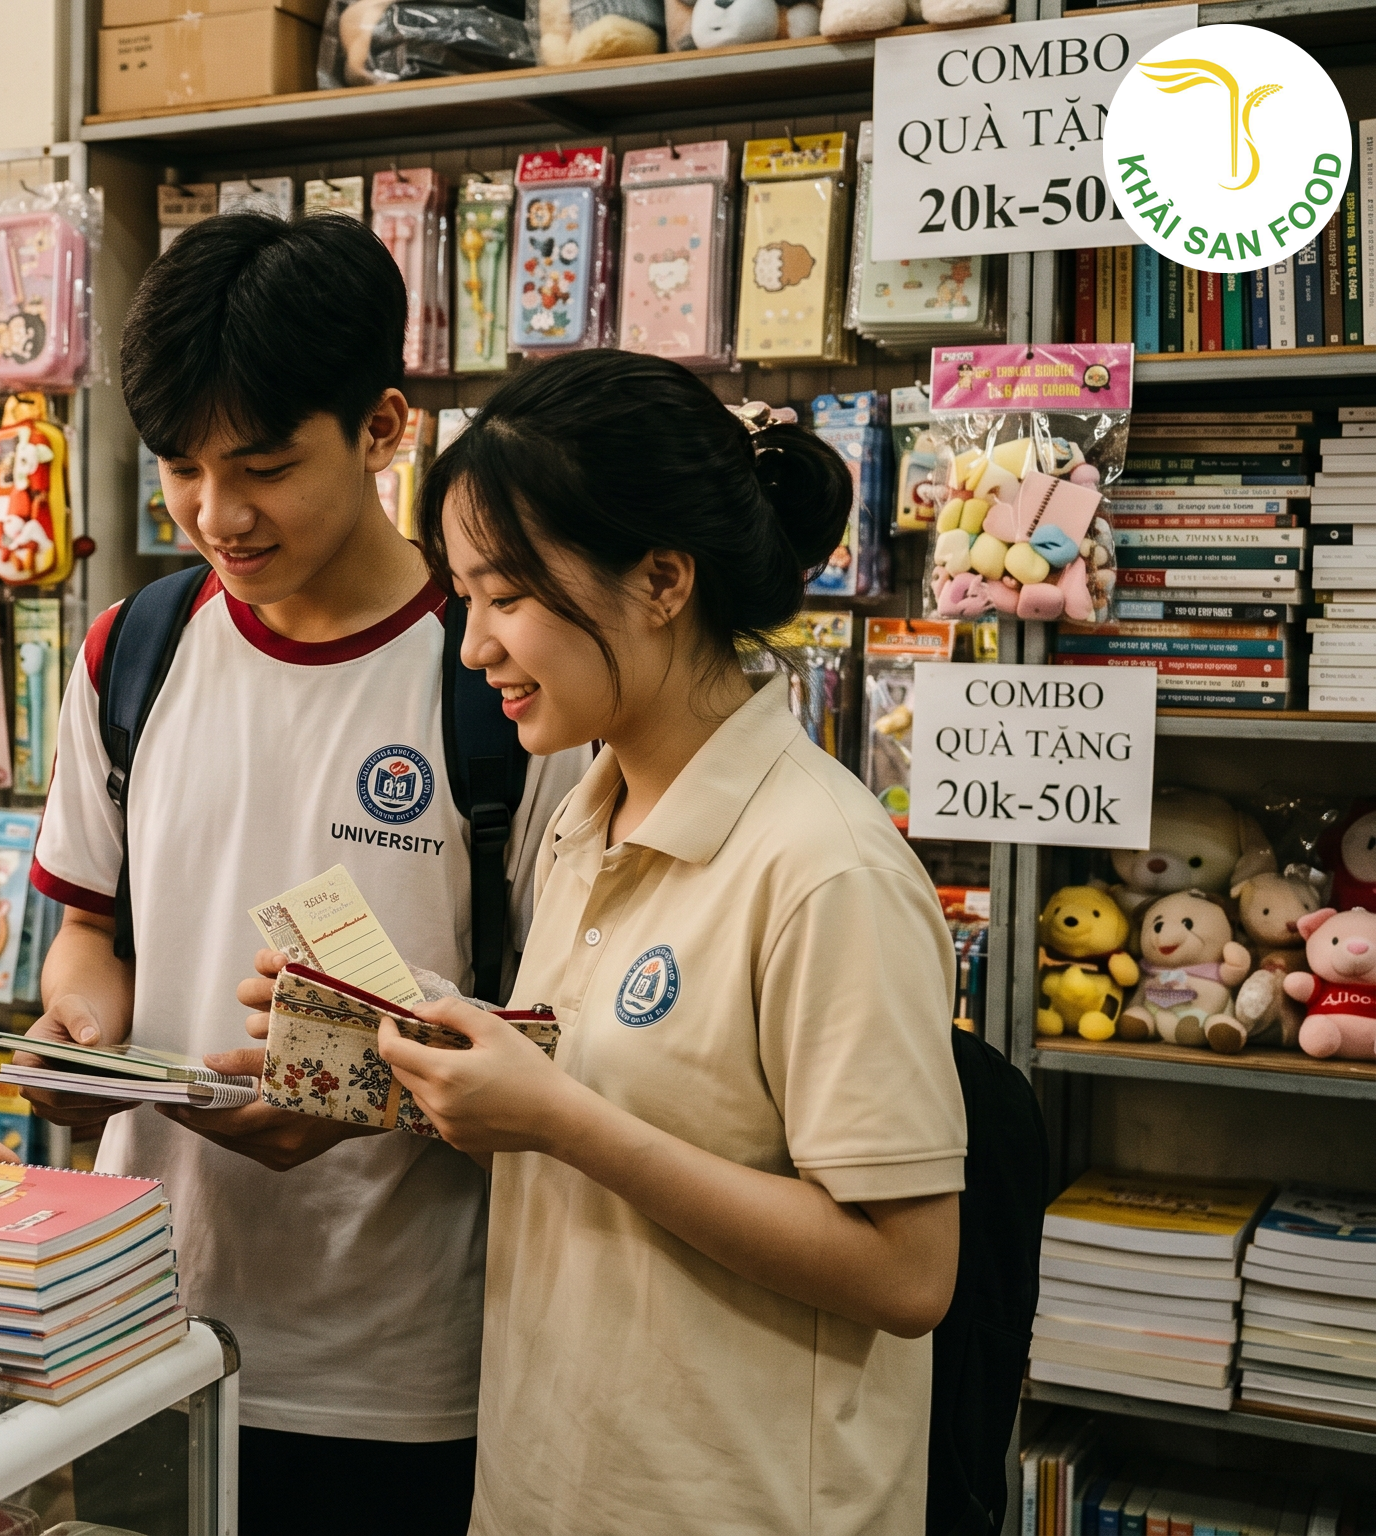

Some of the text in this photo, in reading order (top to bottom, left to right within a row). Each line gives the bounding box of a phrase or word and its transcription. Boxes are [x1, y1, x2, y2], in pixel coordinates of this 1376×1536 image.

[937, 32, 1130, 88] COMBO
[898, 102, 1008, 165] QUÀ
[965, 680, 1104, 710] COMBO
[935, 721, 1132, 765] QUÀ TẶNG
[935, 779, 1121, 825] 20k-50k
[331, 823, 445, 856] UNIVERSITY
